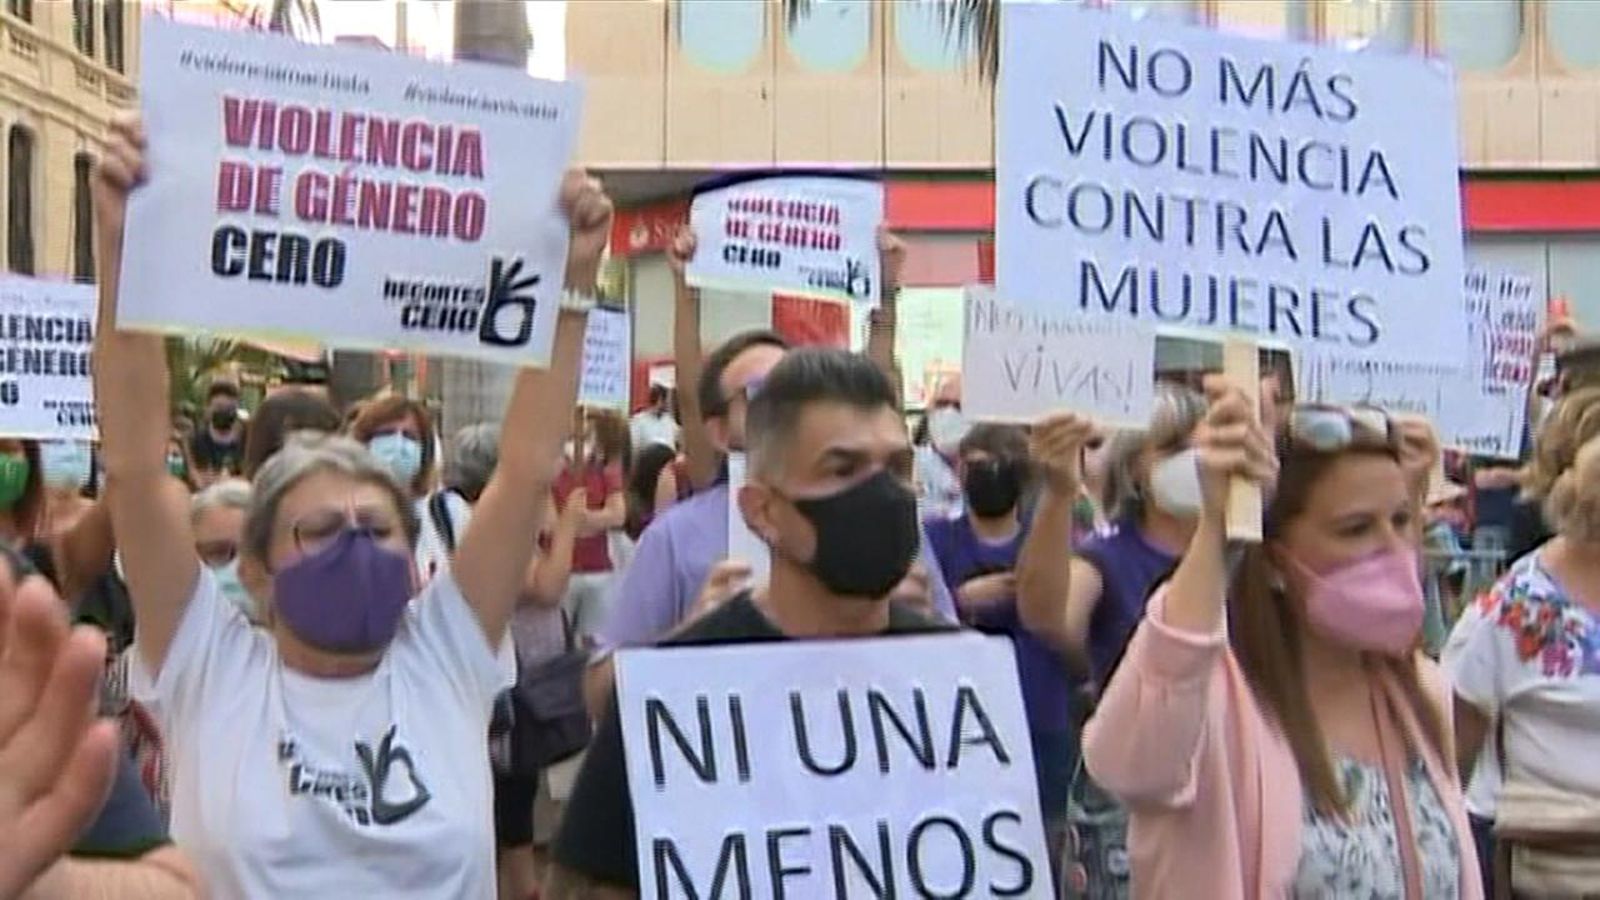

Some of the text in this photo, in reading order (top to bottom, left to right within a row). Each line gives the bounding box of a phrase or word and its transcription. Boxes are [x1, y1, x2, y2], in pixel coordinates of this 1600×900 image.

[1098, 39, 1358, 122] NO MÁS
[222, 96, 485, 180] VIOLENCIA
[1054, 104, 1400, 200] VIOLENCIA
[217, 159, 487, 243] DE GÉNERO
[1024, 175, 1431, 276] CONTRA LAS
[211, 225, 347, 289] CERO
[384, 279, 486, 304] RECORTES
[723, 245, 782, 269] CERO
[402, 304, 478, 331] CERO
[1079, 259, 1380, 347] MUJERES
[645, 686, 1011, 790] NI UNA
[651, 810, 1035, 900] MENOS
